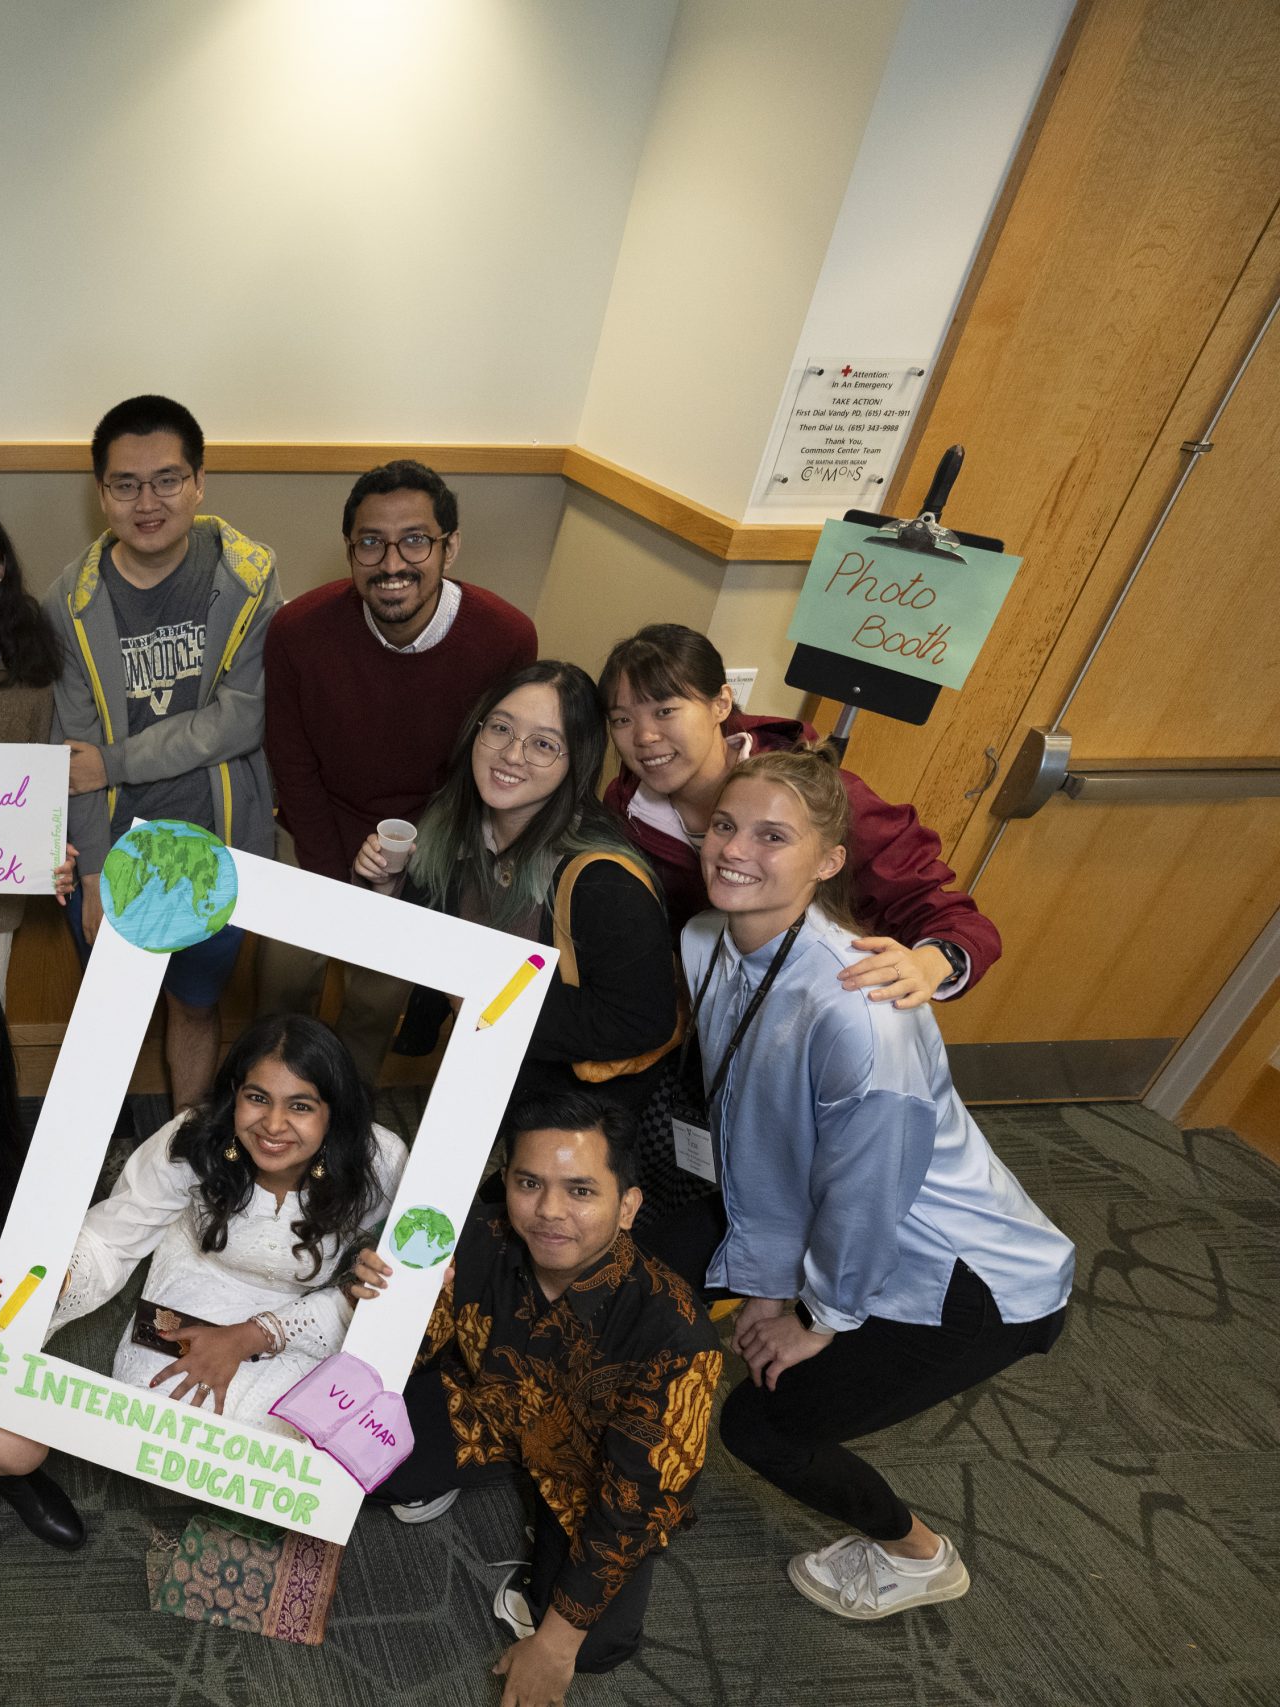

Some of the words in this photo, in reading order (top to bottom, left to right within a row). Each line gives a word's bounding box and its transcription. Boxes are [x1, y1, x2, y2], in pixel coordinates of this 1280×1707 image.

[852, 370, 890, 378] Attention:
[854, 381, 893, 390] Emergency
[828, 409, 849, 418] Vandy
[865, 409, 881, 417] (615)
[848, 424, 865, 432] (615)
[825, 437, 846, 445] Thank
[824, 551, 937, 609] Photo
[851, 614, 952, 665] Booth
[329, 1383, 355, 1410] VU
[136, 1441, 320, 1525] EDUCATOR
